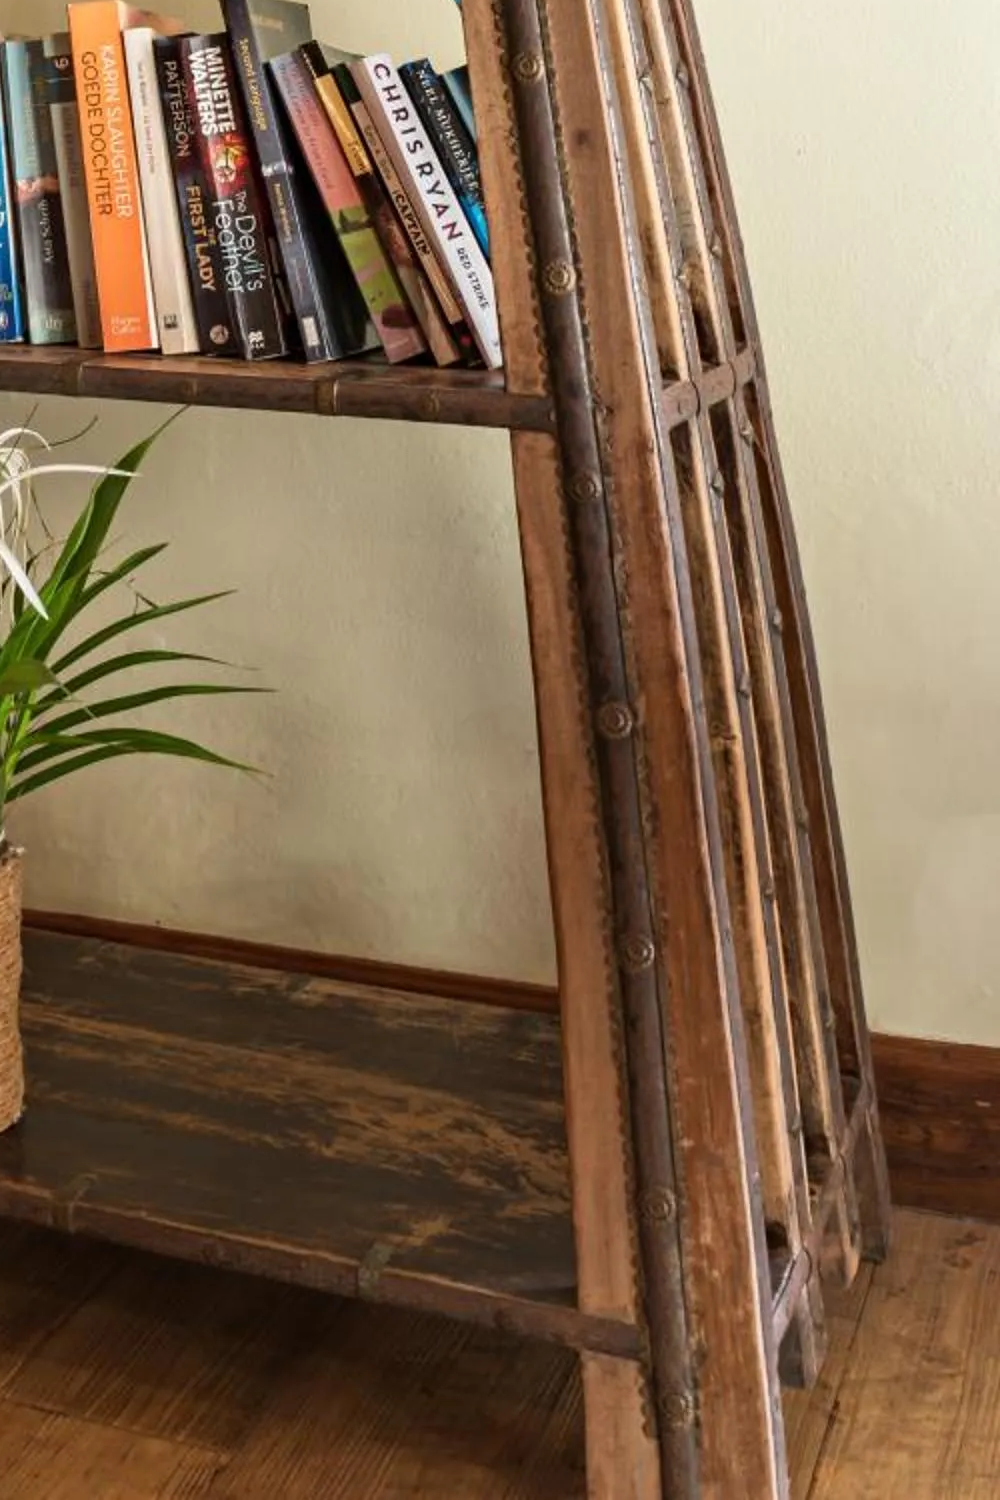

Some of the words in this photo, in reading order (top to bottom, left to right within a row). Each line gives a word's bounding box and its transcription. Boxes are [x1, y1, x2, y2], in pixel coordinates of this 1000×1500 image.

[81, 51, 103, 120] GOEDE
[102, 45, 121, 101] KARIN
[164, 61, 191, 158] PATTERSON
[188, 51, 221, 138] WALTERS
[206, 47, 237, 132] MINETTE
[89, 124, 113, 217] DOCHTER
[107, 106, 133, 219] SLAUGHTER
[235, 191, 248, 217] The
[373, 62, 425, 156] CHRIS
[417, 162, 463, 242] RYAN
[467, 271, 490, 310] STRIKE
[187, 186, 207, 239] FIRST
[212, 200, 245, 293] Feather
[235, 214, 264, 292] Devil's
[195, 241, 216, 293] LADY
